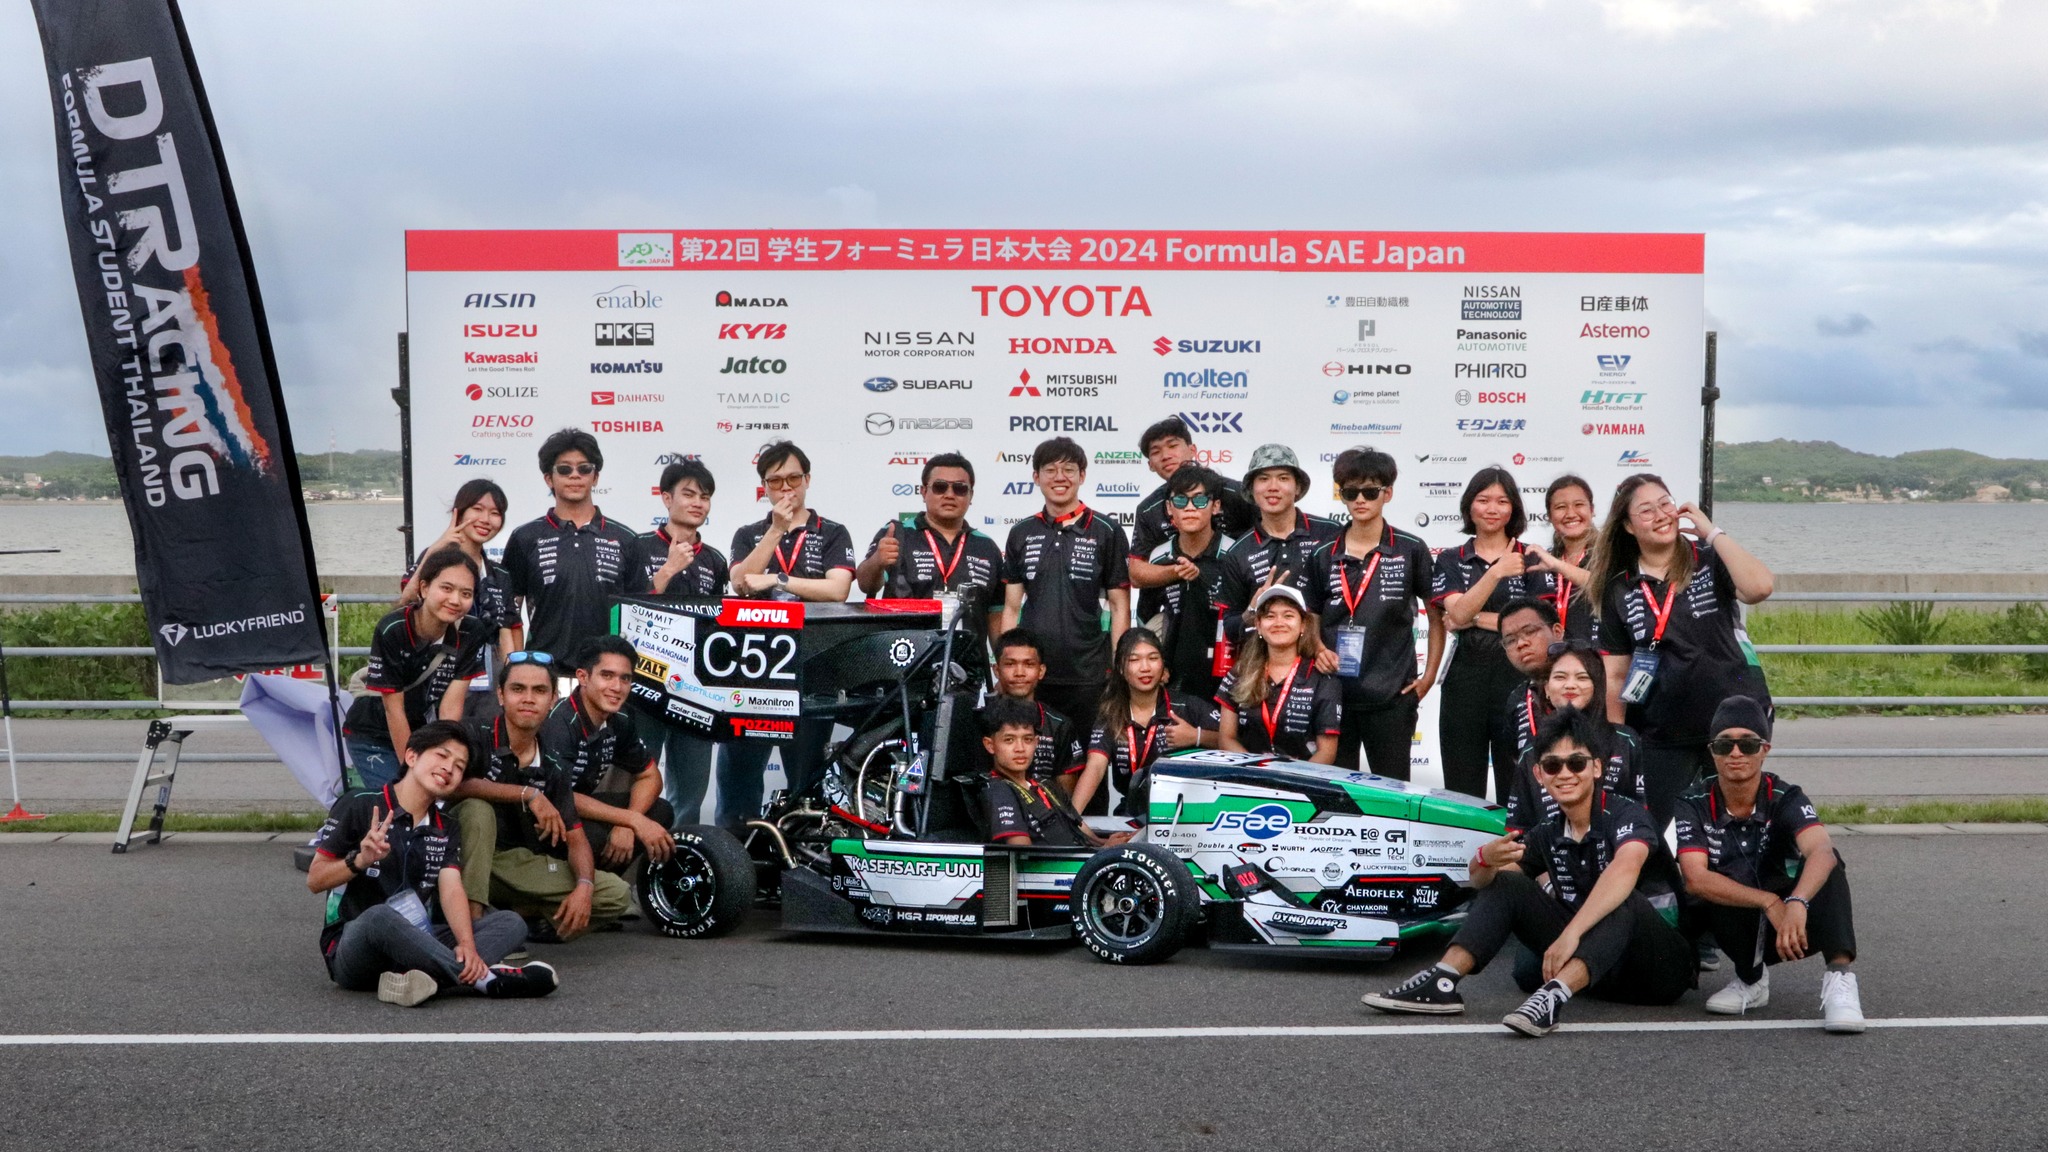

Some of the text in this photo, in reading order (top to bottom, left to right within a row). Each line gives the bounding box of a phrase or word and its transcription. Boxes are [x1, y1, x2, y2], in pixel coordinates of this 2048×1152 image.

[680, 237, 759, 262] 第22回
[1080, 238, 1158, 262] 2024
[1167, 238, 1296, 264] Formula
[1306, 240, 1364, 264] SAE
[1372, 240, 1465, 269] Japan
[61, 72, 166, 508] FORMULA STUDENT THAILAND
[1464, 286, 1521, 297] NISSAN
[464, 293, 536, 308] AISIN
[596, 288, 663, 309] enable
[716, 290, 788, 308] AMADA
[972, 285, 1152, 316] TOYOTA
[1346, 296, 1410, 308] 豊田自動織機
[1581, 296, 1648, 312] 日産車体
[1464, 301, 1520, 310] AUTOMOTIVE
[1464, 311, 1520, 319] TECHNOLOGY
[464, 324, 538, 338] ISUZU
[597, 324, 652, 342] HKS
[718, 324, 788, 340] KYB
[1456, 329, 1526, 340] Panasonic
[1580, 323, 1650, 338] Astemo
[865, 332, 974, 345] NISSAN
[1008, 338, 1116, 354] HONDA
[1178, 340, 1260, 352] SUZUKI
[1456, 342, 1526, 352] AUTOMOTIVE
[464, 352, 538, 364] Kawasaki
[591, 360, 662, 374] KOMATSU
[720, 356, 787, 374] Jatco
[1348, 364, 1412, 375] HINO
[1455, 364, 1526, 378] PHIARO
[1047, 375, 1116, 384] MITSUBISHI
[1164, 368, 1247, 388] molten
[903, 380, 972, 390] SUBARU
[488, 386, 538, 398] SOLIZE
[618, 394, 664, 402] DAIHATSU
[717, 393, 790, 403] TAMADIC
[1047, 388, 1098, 397] MOTORS
[1478, 392, 1526, 404] BOSCH
[1580, 390, 1647, 403] HTFT
[472, 416, 534, 428] DENSO
[592, 421, 664, 432] TOSHIBA
[1010, 416, 1118, 432] PROTERIAL
[1596, 424, 1644, 435] YAMAHA
[454, 454, 506, 466] AIKITEC
[1002, 482, 1034, 494] ATJ
[1096, 483, 1140, 492] Autoliv
[632, 606, 674, 626] SUMMIT
[736, 608, 789, 623] MOTUL
[193, 610, 304, 639] LUCKYFRIEND
[628, 622, 668, 642] LENSO
[671, 638, 695, 651] msi
[640, 640, 655, 650] ASIA
[656, 646, 689, 663] KANGNAM
[703, 632, 796, 680] C52
[748, 696, 794, 707] Maxnitron
[670, 703, 712, 723] Solar Gard
[730, 718, 795, 736] TOZZHIN
[1294, 826, 1357, 836] HONDA
[852, 857, 980, 877] KASETSART UNI
[1345, 884, 1404, 898] AEROFLEX
[897, 912, 922, 921] HGR
[1273, 912, 1307, 926] DYNO
